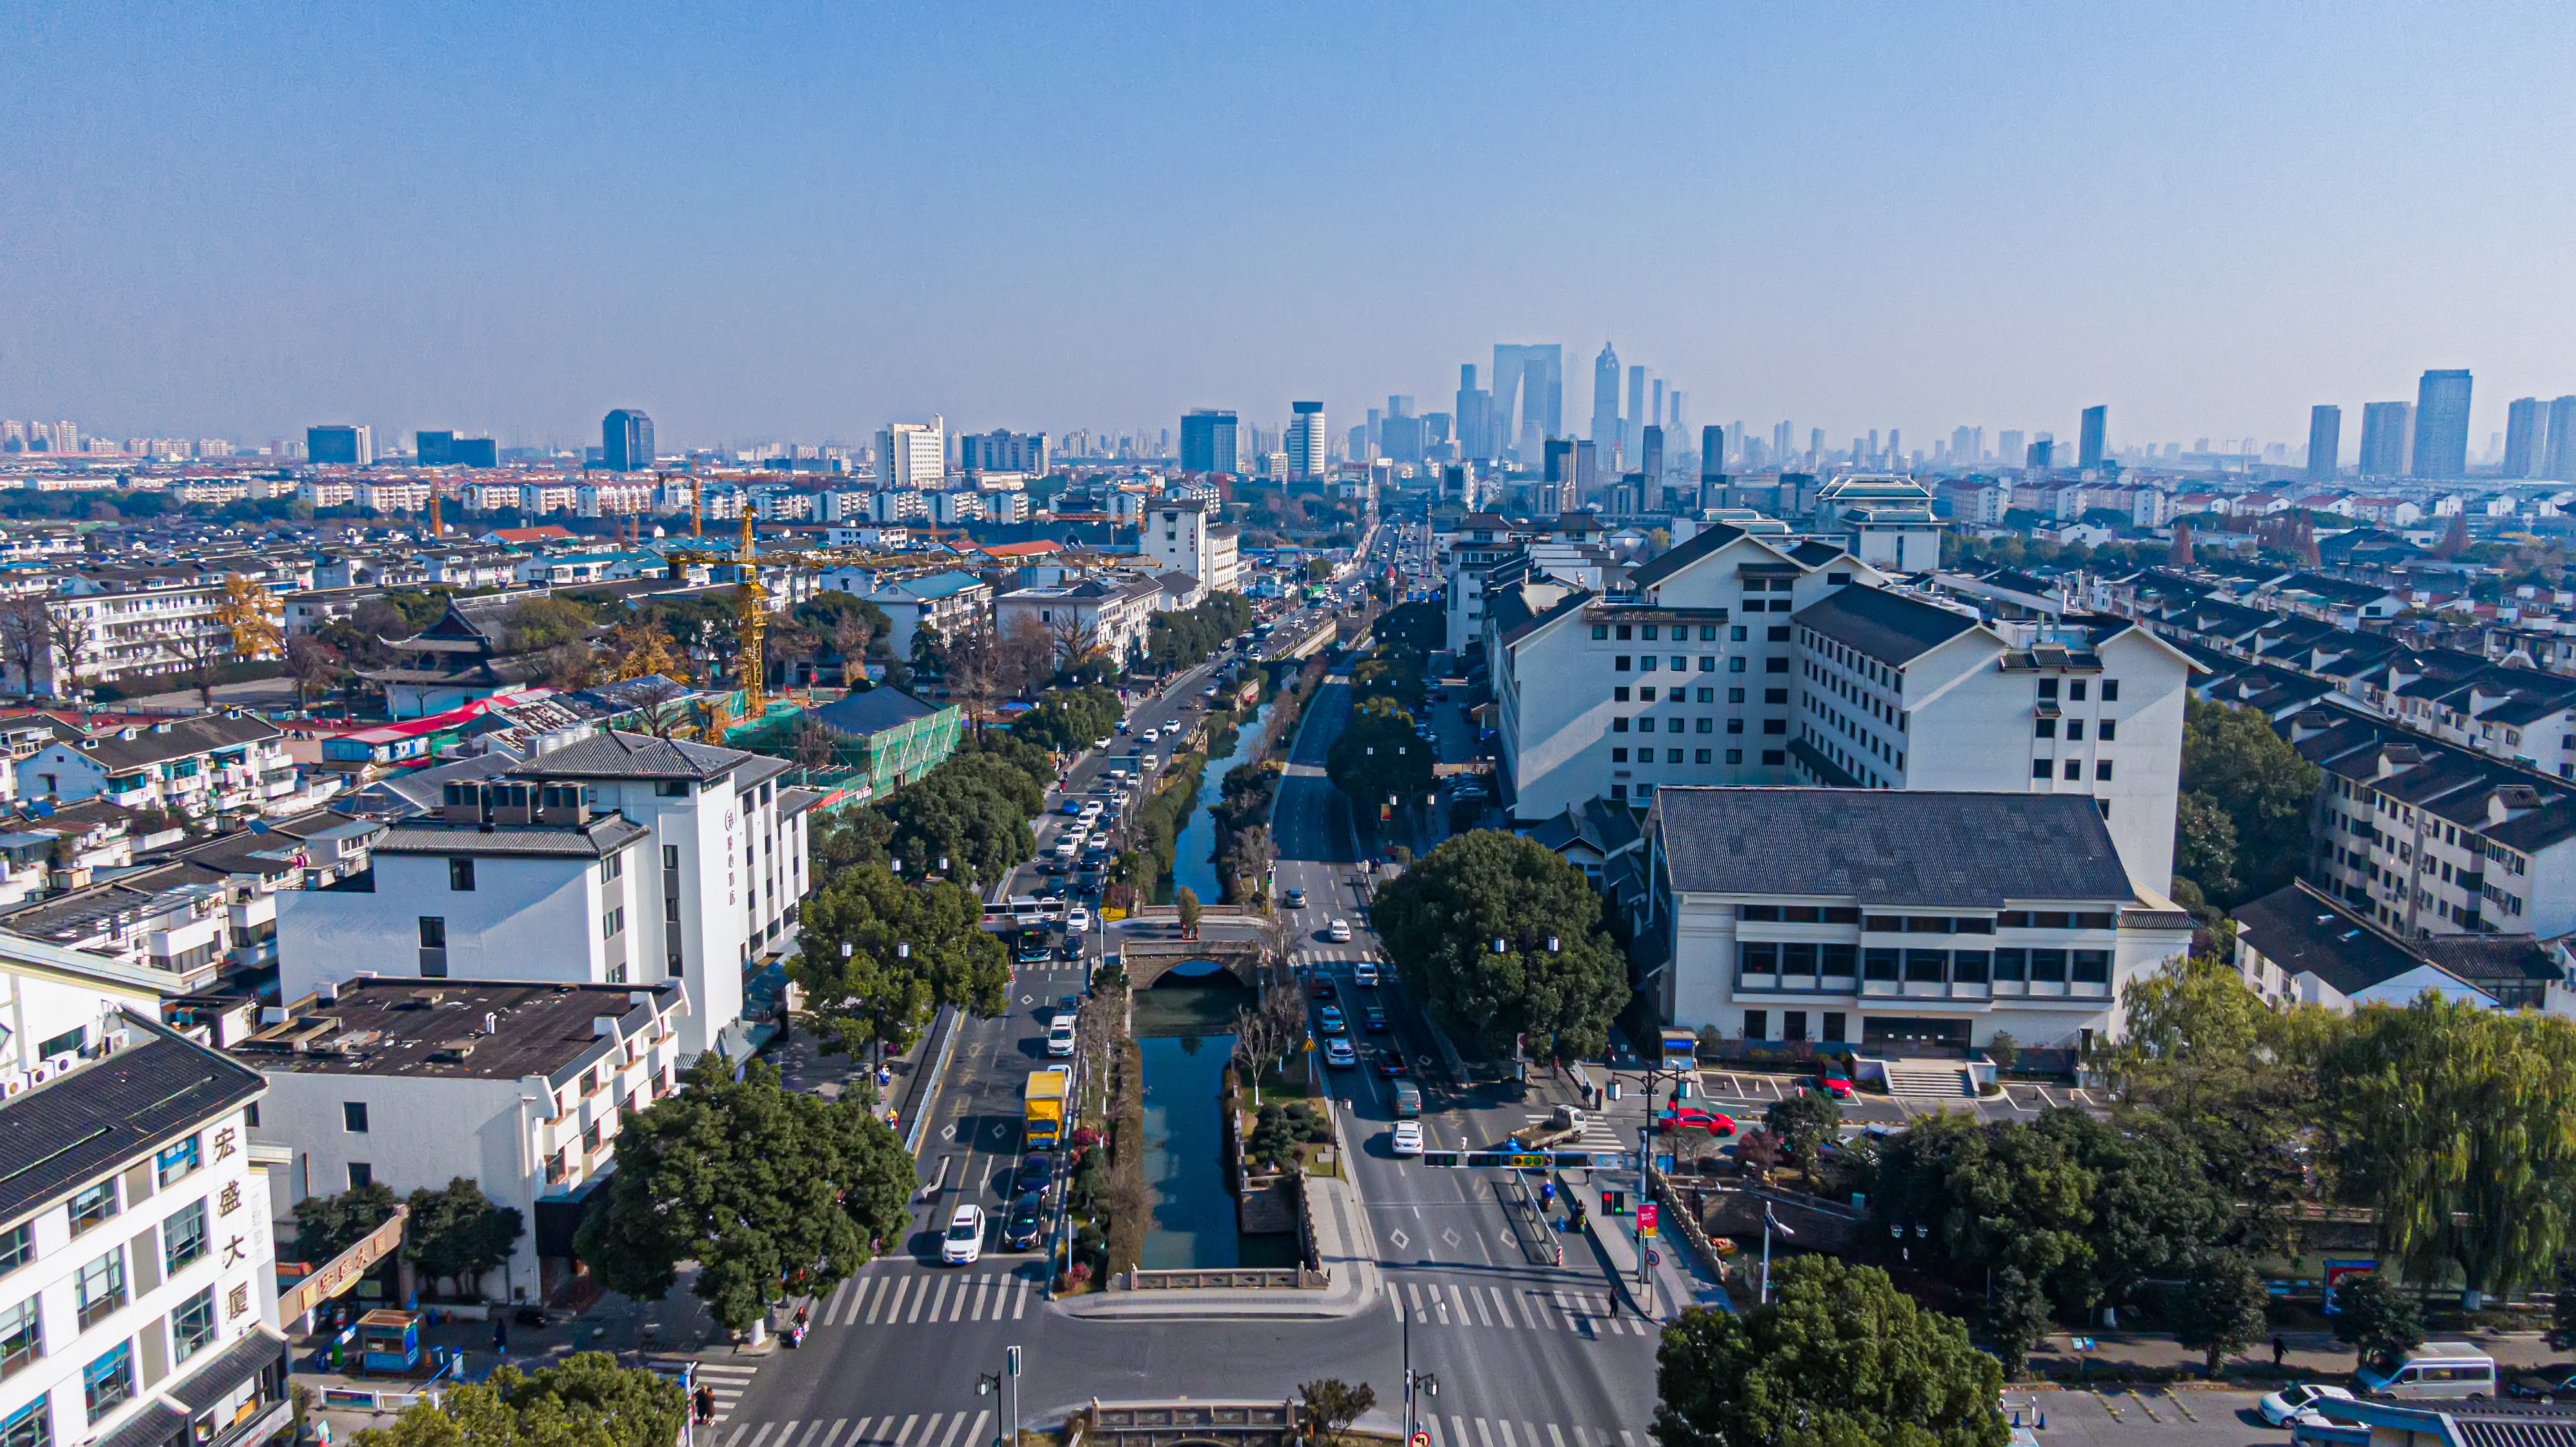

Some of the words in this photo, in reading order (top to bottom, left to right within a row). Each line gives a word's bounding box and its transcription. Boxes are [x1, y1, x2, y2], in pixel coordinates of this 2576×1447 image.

[214, 1126, 249, 1320] 宏盛大厦
[320, 1233, 385, 1293] 宏盛大厦
